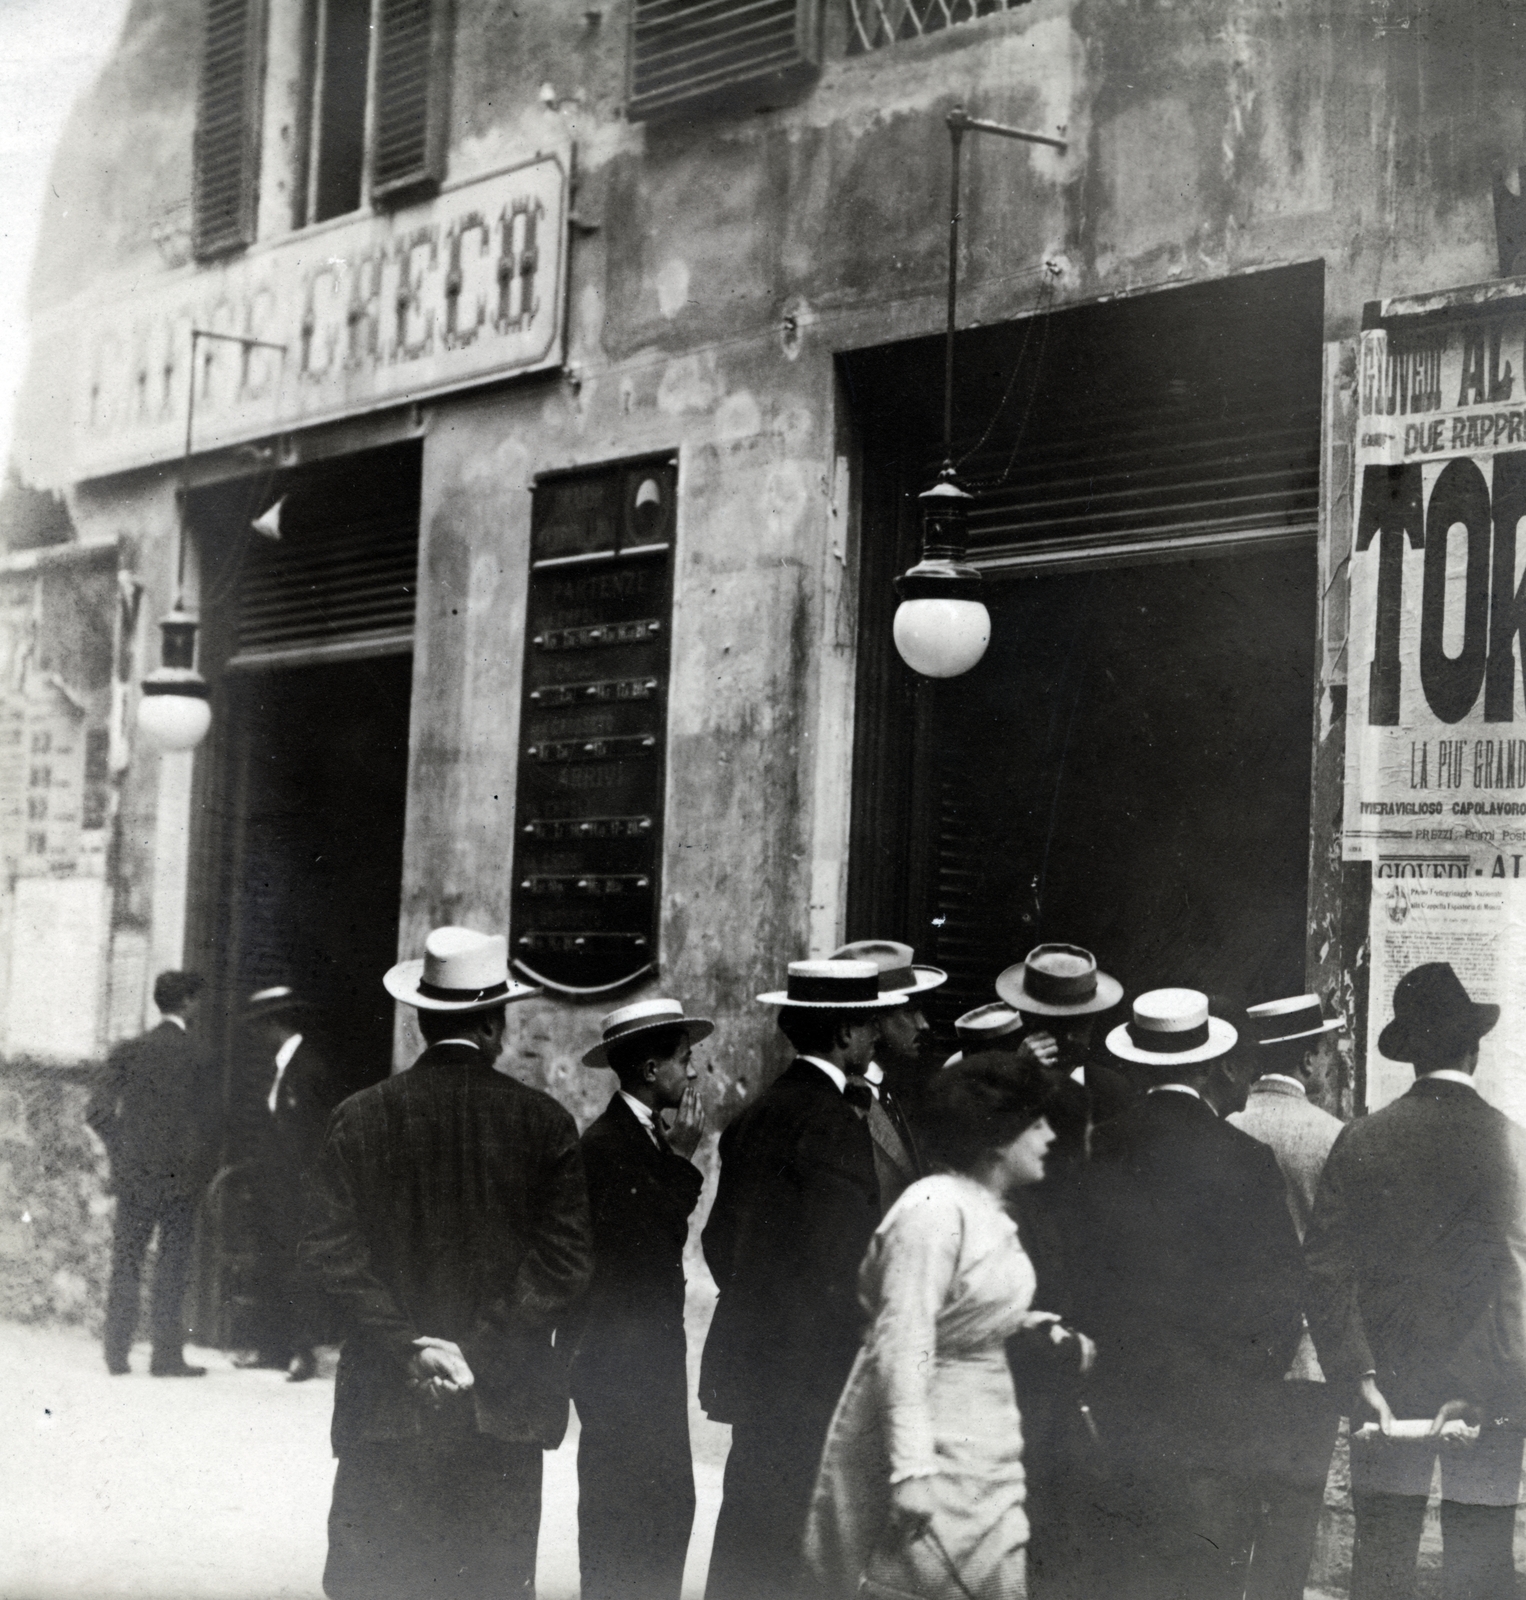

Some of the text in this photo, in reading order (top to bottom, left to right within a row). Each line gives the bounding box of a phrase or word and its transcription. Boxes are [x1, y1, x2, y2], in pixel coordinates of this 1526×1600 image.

[1404, 410, 1526, 456] DUE RAPPR
[1410, 741, 1428, 789] LA
[1473, 740, 1526, 788] GRAND
[1360, 801, 1526, 816] MERAVIGLIOSO CAPOLAVORO
